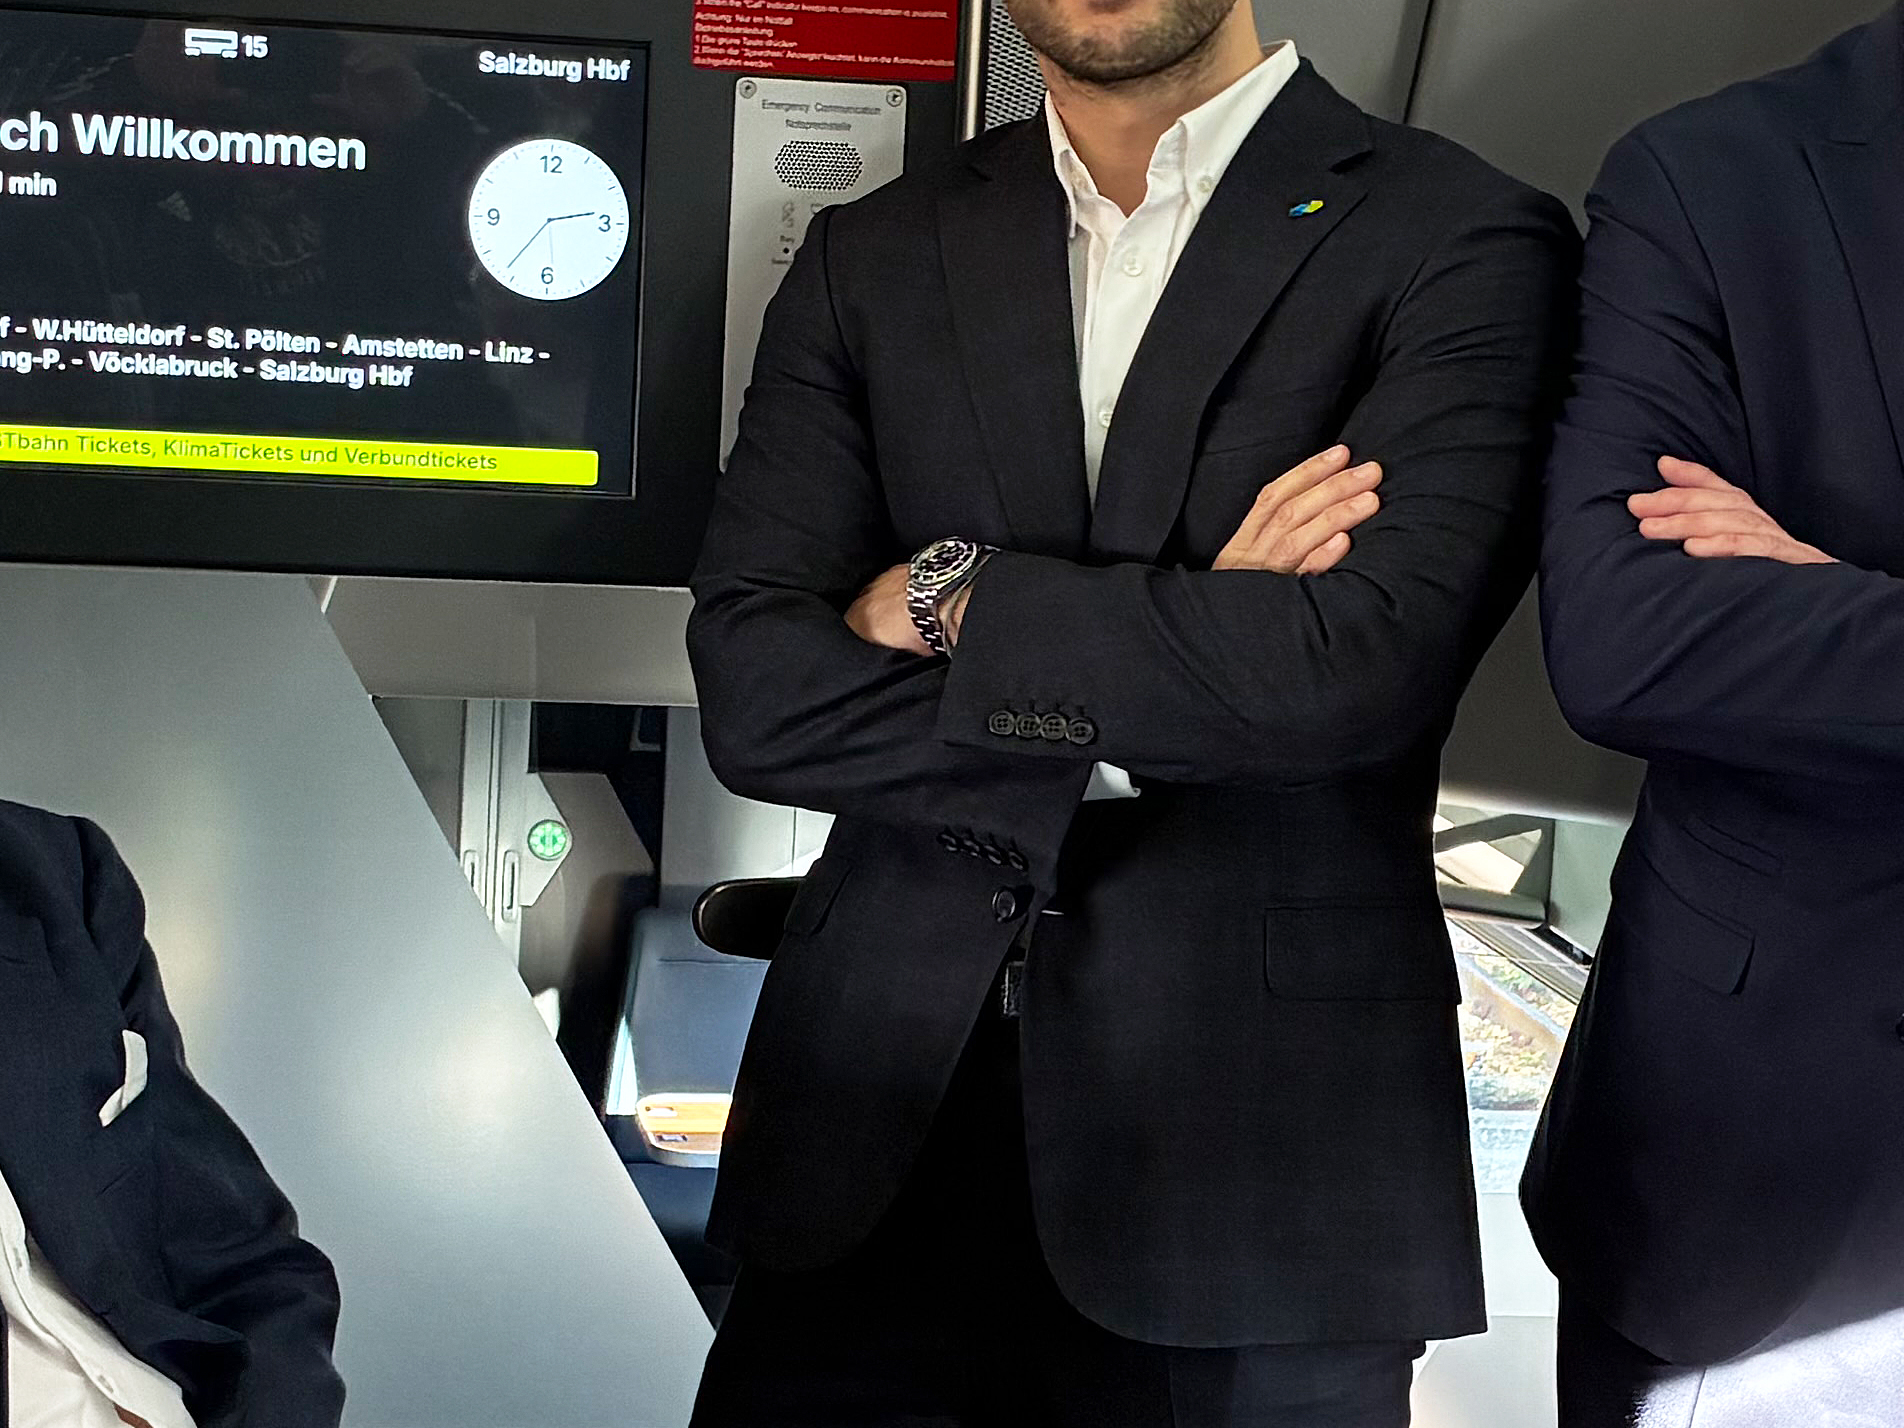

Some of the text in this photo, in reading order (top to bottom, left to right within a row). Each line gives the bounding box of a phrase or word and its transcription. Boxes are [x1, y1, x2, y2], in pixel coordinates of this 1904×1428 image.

[241, 34, 269, 59] 15
[478, 50, 631, 83] Salzburg Hbf
[72, 112, 366, 170] Willkommen
[539, 156, 563, 174] 12
[8, 171, 57, 197] min
[486, 208, 500, 226] 9
[598, 215, 612, 232] 3
[540, 267, 555, 285] 6
[32, 318, 186, 347] W.Hütteldorf
[207, 326, 240, 350] St.
[246, 328, 321, 354] Pölten
[342, 333, 464, 361] Amstetten
[484, 340, 534, 365] Linz
[88, 350, 239, 379] Vöcklabruck
[259, 358, 366, 390] Salzburg
[369, 364, 414, 388] Hbf
[77, 436, 157, 458] Tickets,
[164, 439, 294, 462] KlimaTickets
[300, 446, 338, 464] und
[345, 447, 498, 470] Verbundtickets
